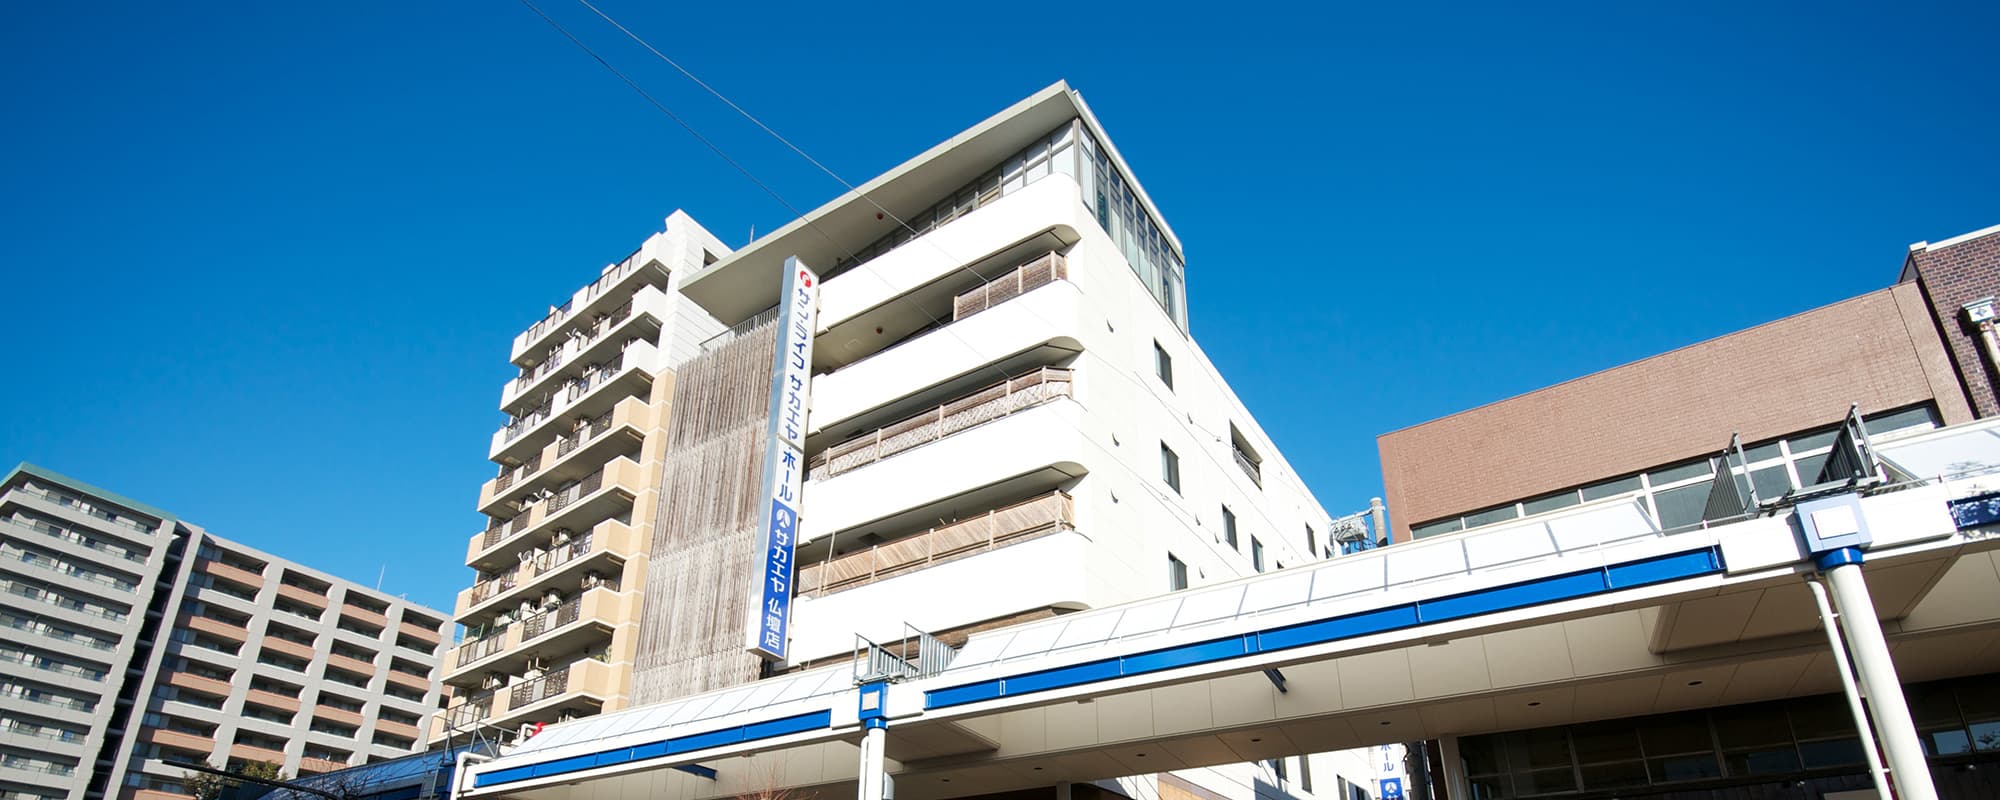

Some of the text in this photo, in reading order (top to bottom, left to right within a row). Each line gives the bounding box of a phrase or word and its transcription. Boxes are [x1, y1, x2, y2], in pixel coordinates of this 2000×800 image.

[764, 529, 789, 650] サカエヤ 仏壇店
